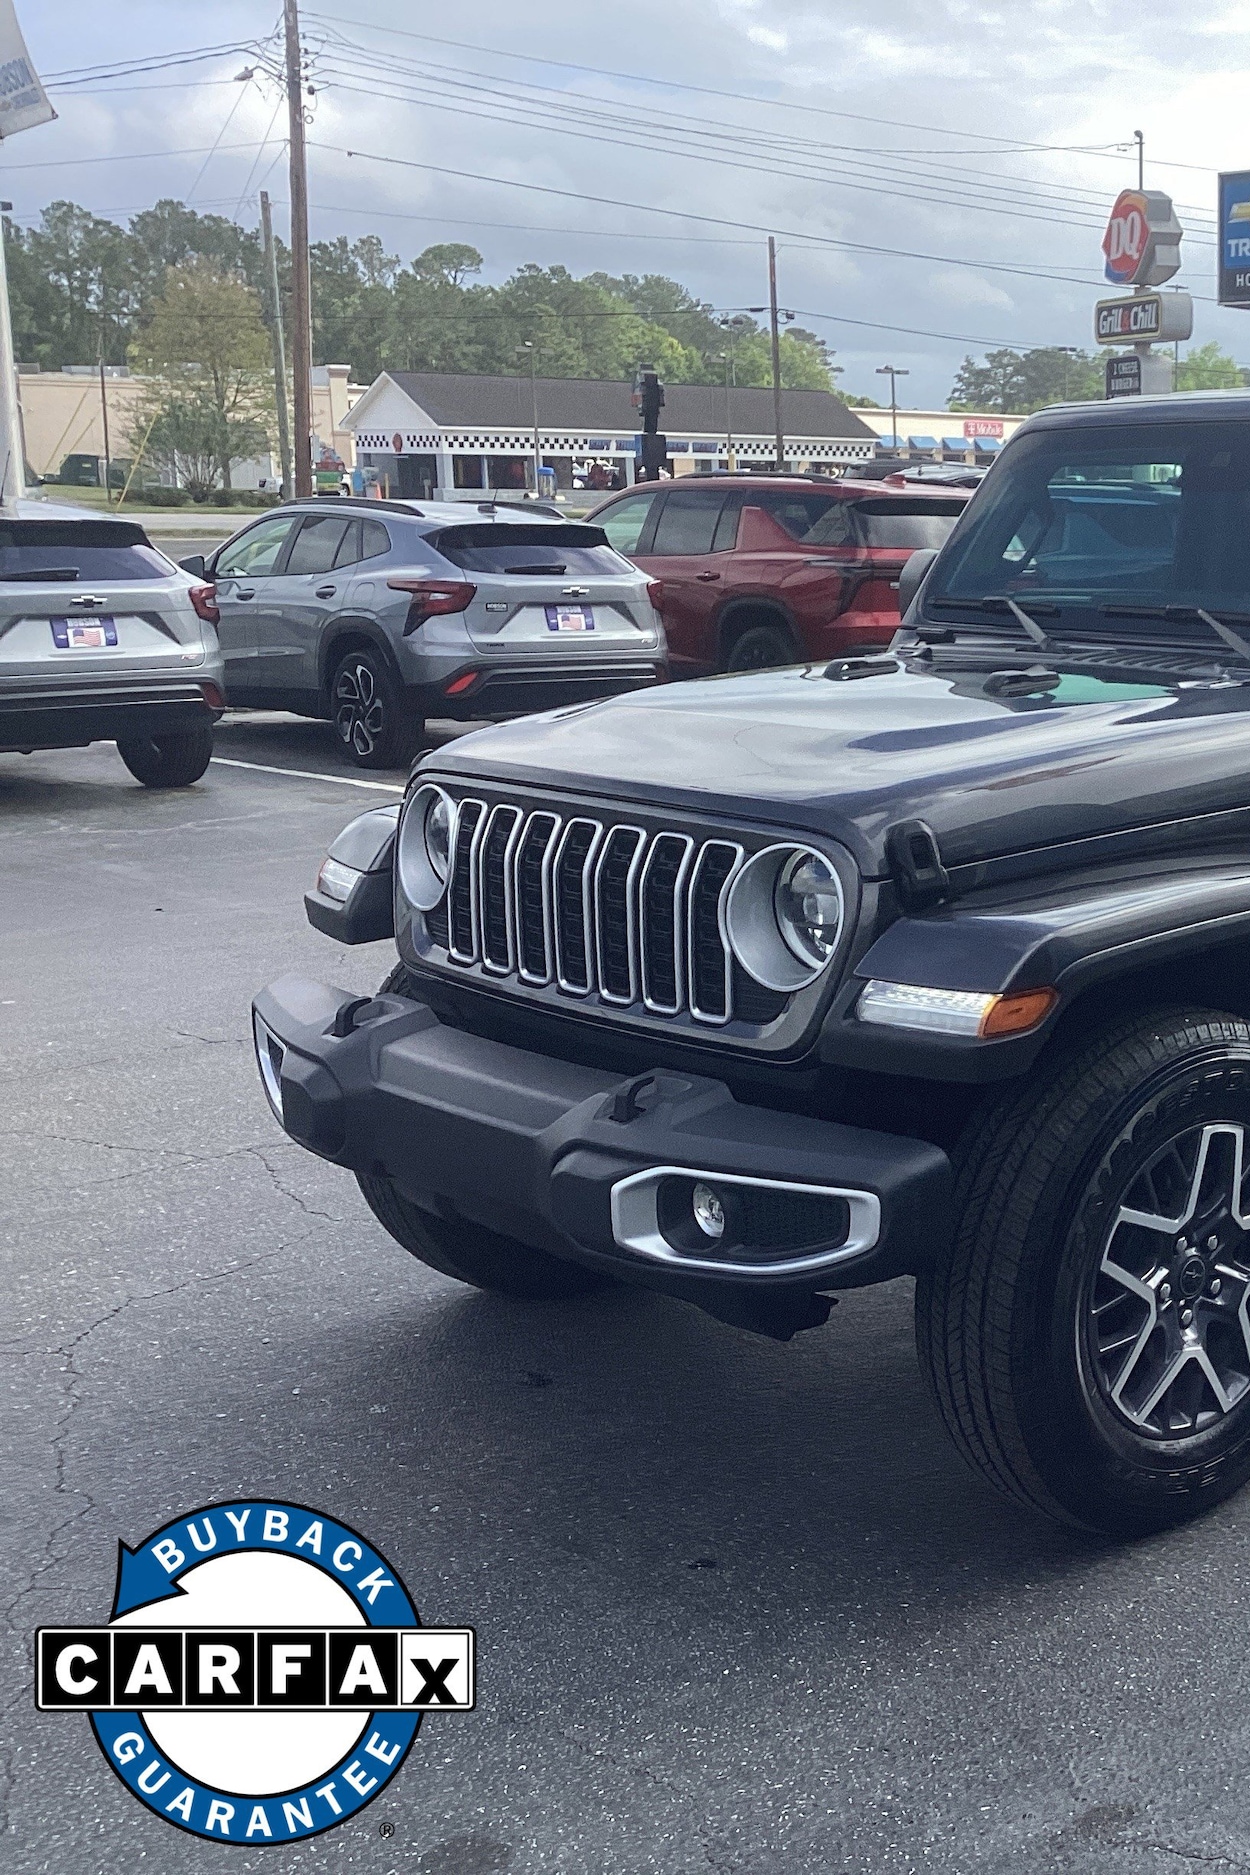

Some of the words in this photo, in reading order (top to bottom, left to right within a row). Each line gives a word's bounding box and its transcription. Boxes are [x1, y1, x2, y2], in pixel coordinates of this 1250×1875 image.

[1109, 211, 1142, 260] DQ
[1099, 309, 1121, 334] Grill
[1130, 302, 1157, 333] Chill
